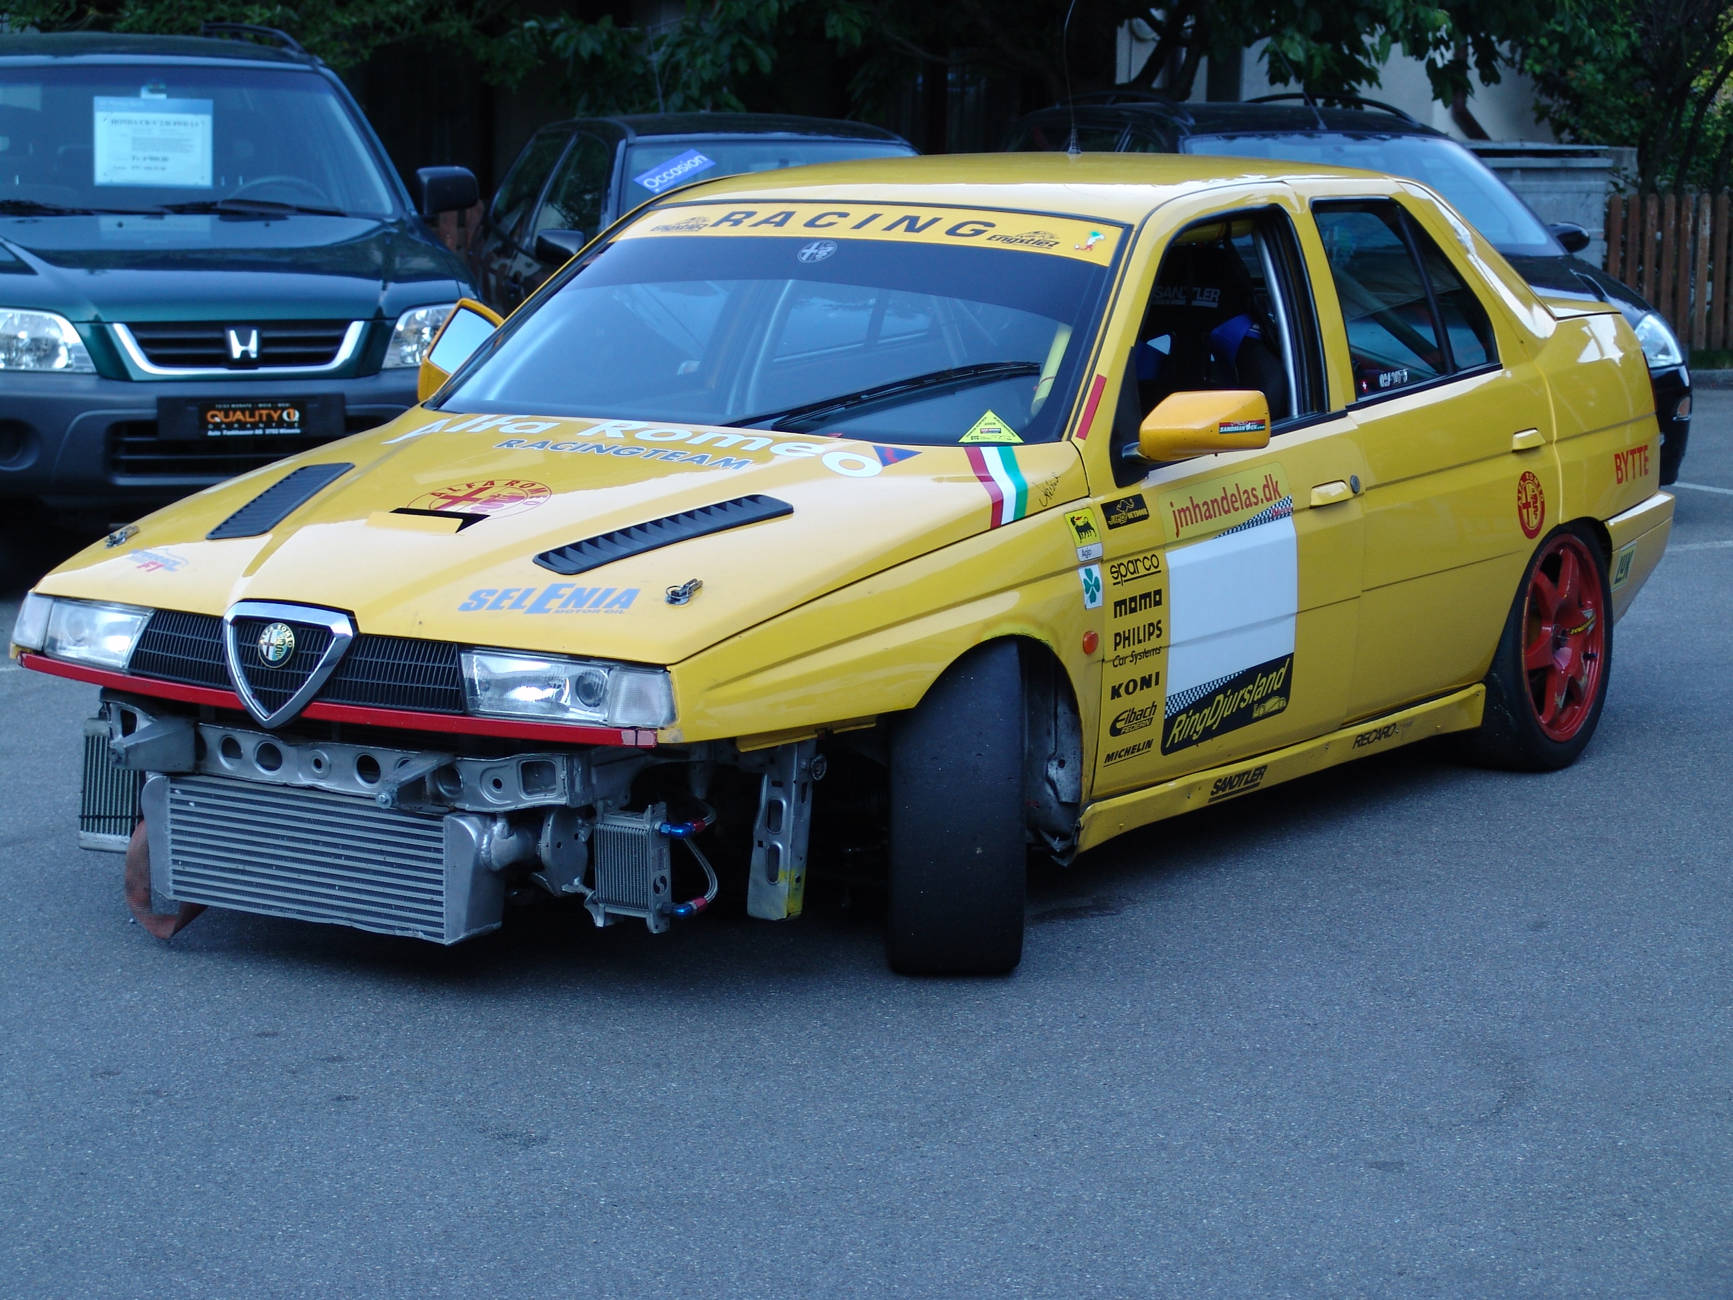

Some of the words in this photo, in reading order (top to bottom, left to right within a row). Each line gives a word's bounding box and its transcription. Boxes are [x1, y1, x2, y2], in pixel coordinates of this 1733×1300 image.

[643, 153, 709, 190] Occasion
[710, 210, 998, 238] RACING
[206, 409, 281, 423] QUALITY
[381, 413, 561, 445] Alfa
[576, 418, 883, 478] Romeo
[493, 438, 753, 471] RACINGTEAM
[1614, 444, 1650, 485] BYTTE
[1169, 473, 1283, 539] jmhandelas.dk
[1109, 553, 1160, 586] sparco
[457, 582, 642, 614] SELENIA
[1113, 618, 1163, 652] PHILIPS
[1112, 654, 1129, 668] Car
[1129, 647, 1162, 665] Systems
[1110, 670, 1161, 701] KONI
[1109, 700, 1158, 738] Eibach
[1165, 657, 1291, 749] RingDjursland
[1103, 738, 1155, 764] MICHELIN
[1351, 722, 1397, 750] RECARO
